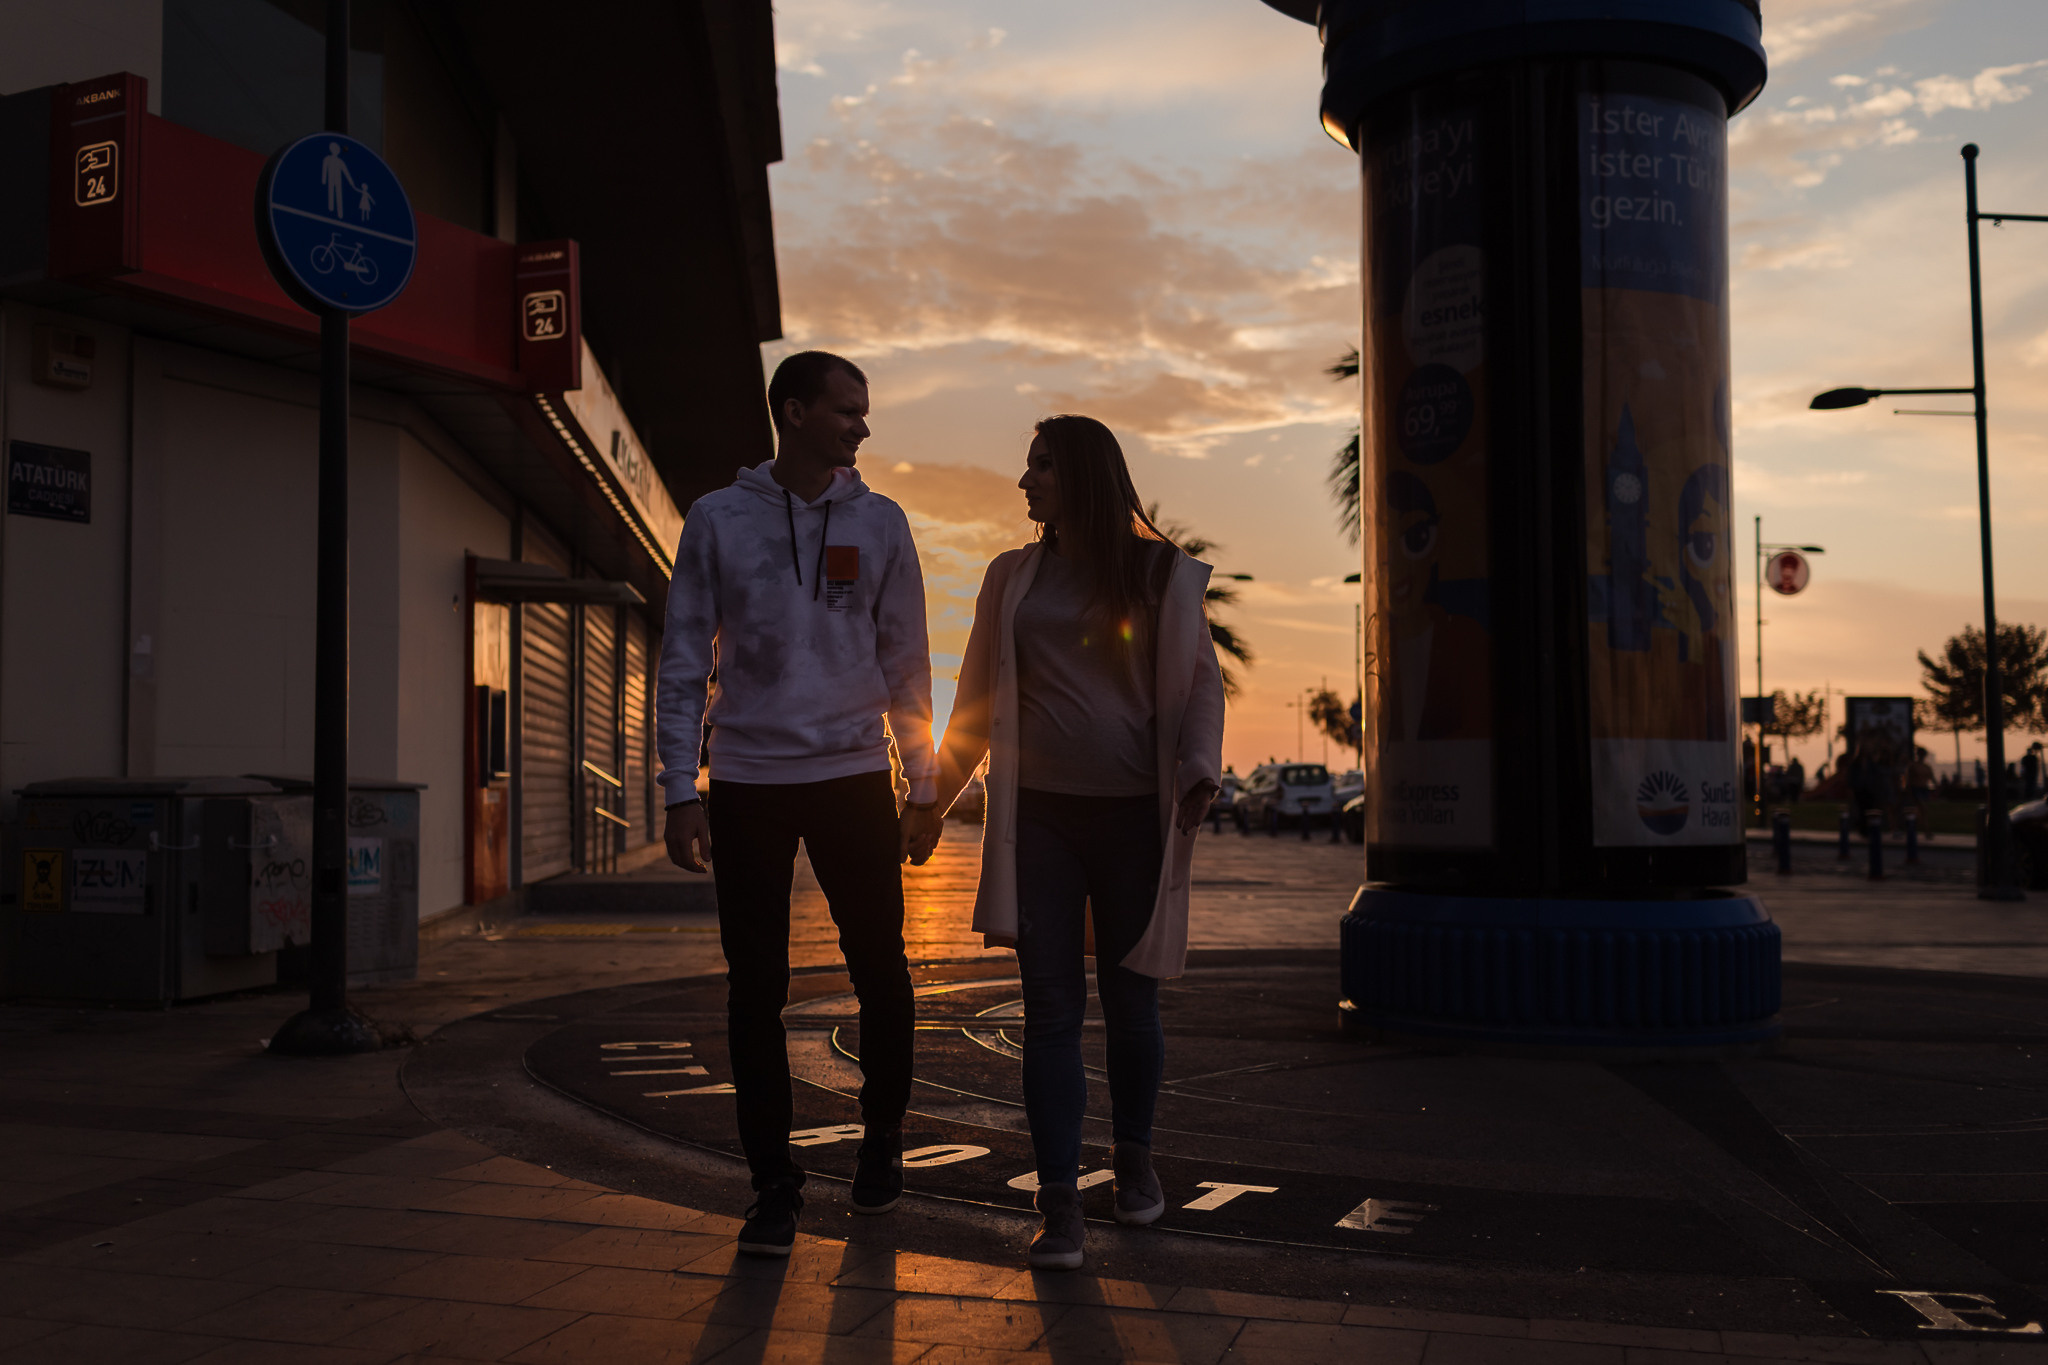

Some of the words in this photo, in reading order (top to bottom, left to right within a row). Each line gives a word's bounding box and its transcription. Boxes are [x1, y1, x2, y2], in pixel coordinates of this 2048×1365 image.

[75, 89, 121, 105] AKBANK
[1589, 94, 1664, 138] İster
[1383, 119, 1473, 170] rupa'yı
[1590, 145, 1660, 180] ister
[86, 175, 107, 200] 24
[1590, 190, 1683, 229] gezin.
[535, 316, 555, 337] 24
[1420, 295, 1490, 327] esnek
[11, 461, 88, 492] ATATÜRK
[1701, 805, 1731, 828] Hava
